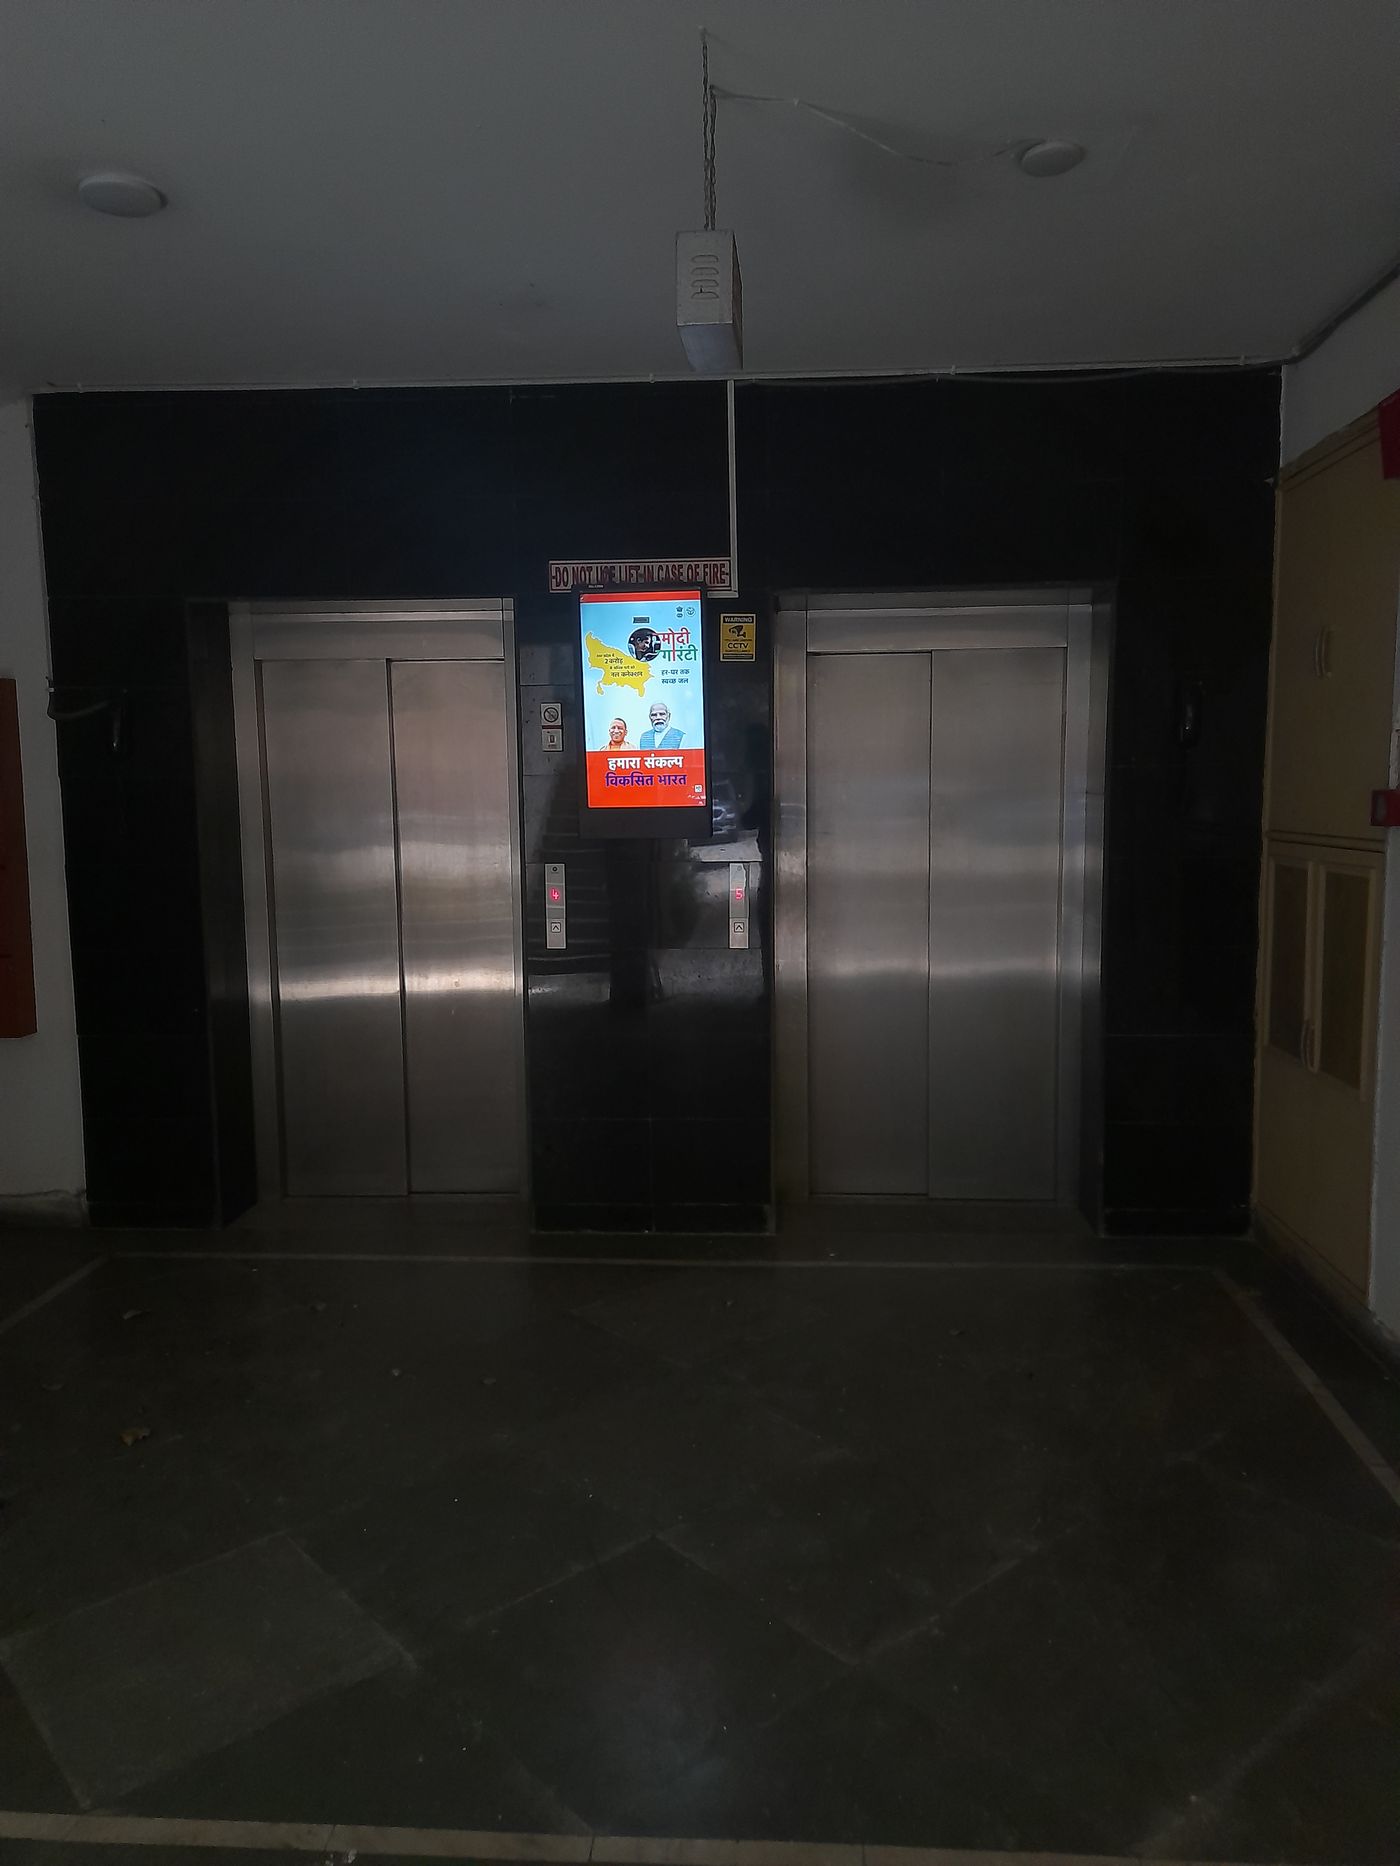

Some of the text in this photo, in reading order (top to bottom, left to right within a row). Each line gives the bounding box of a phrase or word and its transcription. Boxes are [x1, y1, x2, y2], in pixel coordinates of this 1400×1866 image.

[555, 566, 569, 587] DO
[572, 565, 593, 584] NOT
[643, 564, 654, 583] IN
[657, 564, 684, 582] CASE
[687, 563, 700, 582] OF
[703, 563, 726, 585] FIRE
[653, 627, 691, 645] मोदी
[656, 644, 698, 662] गारंटी
[607, 753, 683, 770] हमारा संकल्प
[605, 771, 687, 787] विकसित भारत
[735, 888, 743, 900] 5
